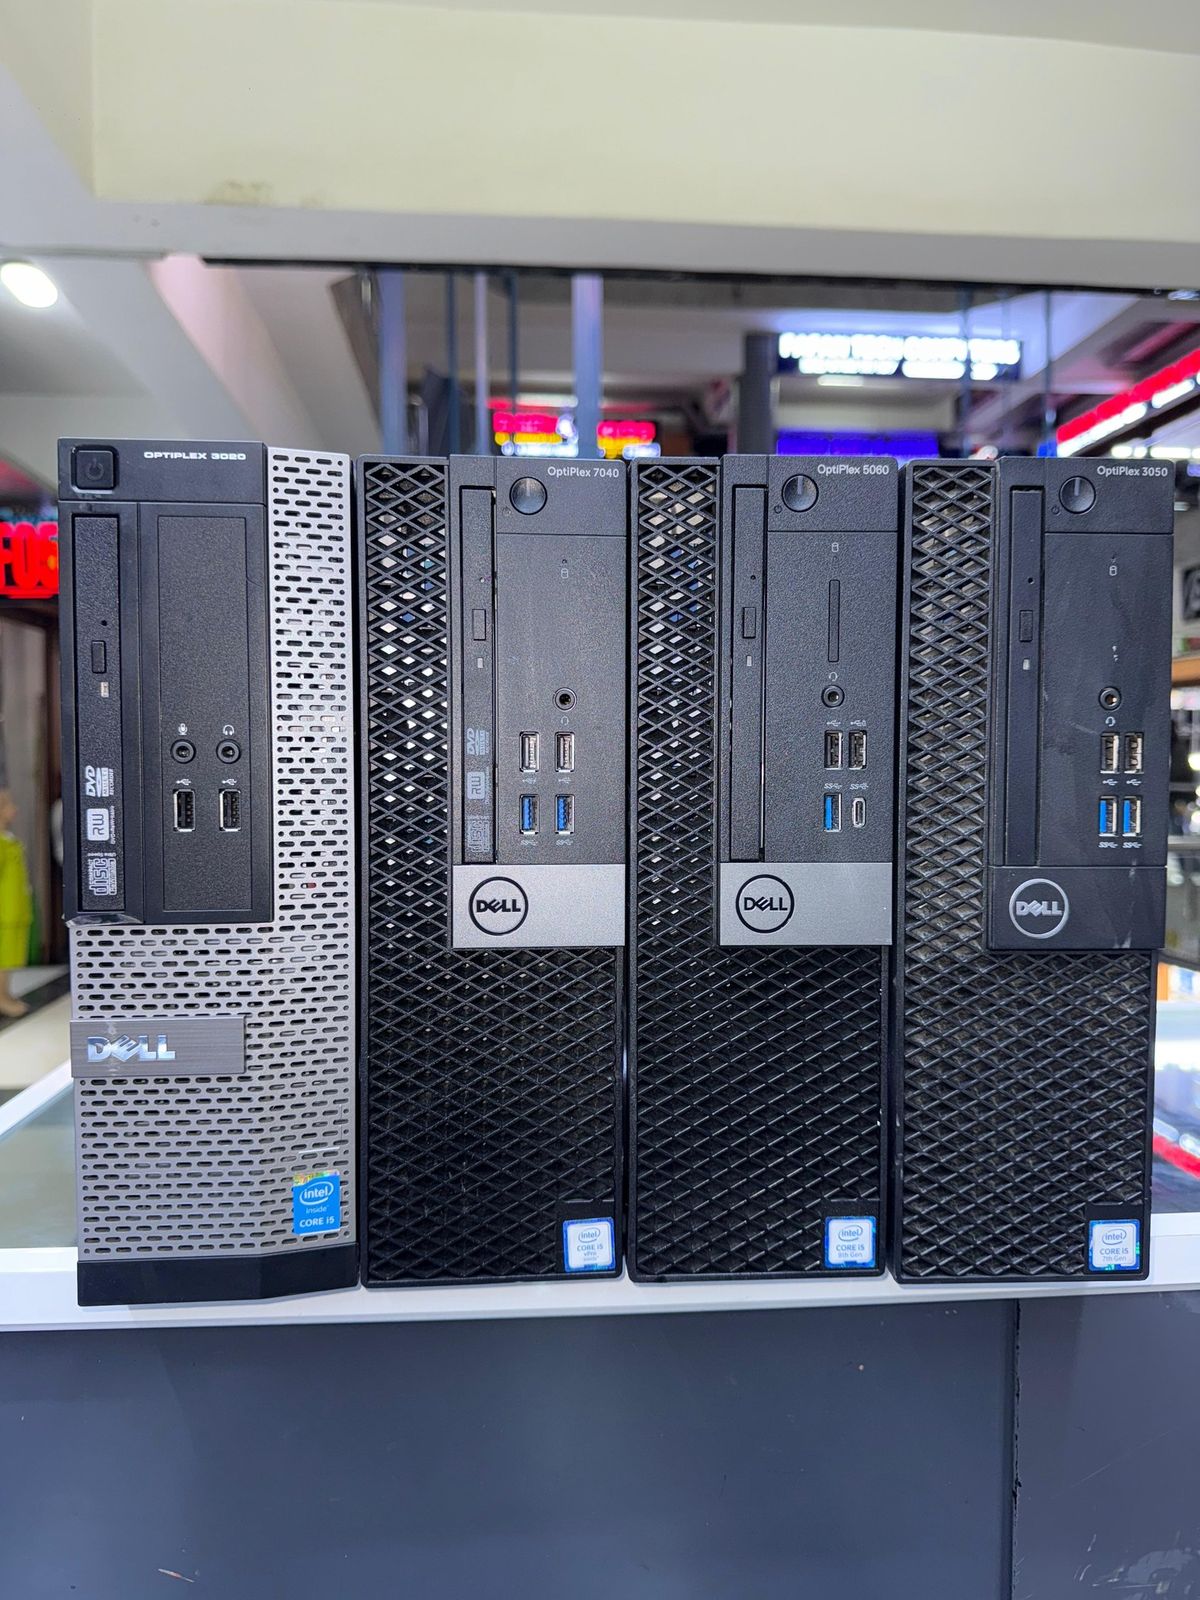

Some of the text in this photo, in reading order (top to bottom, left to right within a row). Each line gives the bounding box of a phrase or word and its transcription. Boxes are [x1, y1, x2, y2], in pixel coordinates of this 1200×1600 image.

[143, 451, 247, 461] OPTIPLEX 3020
[547, 466, 620, 478] OptiPlex 7040
[817, 464, 890, 477] OptiPlex 5060
[1096, 465, 1168, 477] OptiPlex 3050
[85, 765, 96, 797] DVD
[476, 898, 521, 914] DELL
[743, 896, 788, 911] DELL
[1015, 899, 1063, 916] DELL
[87, 1034, 176, 1062] DELL
[303, 1186, 329, 1199] intel
[299, 1215, 335, 1228] CORE i5
[576, 1243, 596, 1252] CORE
[836, 1244, 857, 1252] CORE
[1099, 1247, 1121, 1255] CORE
